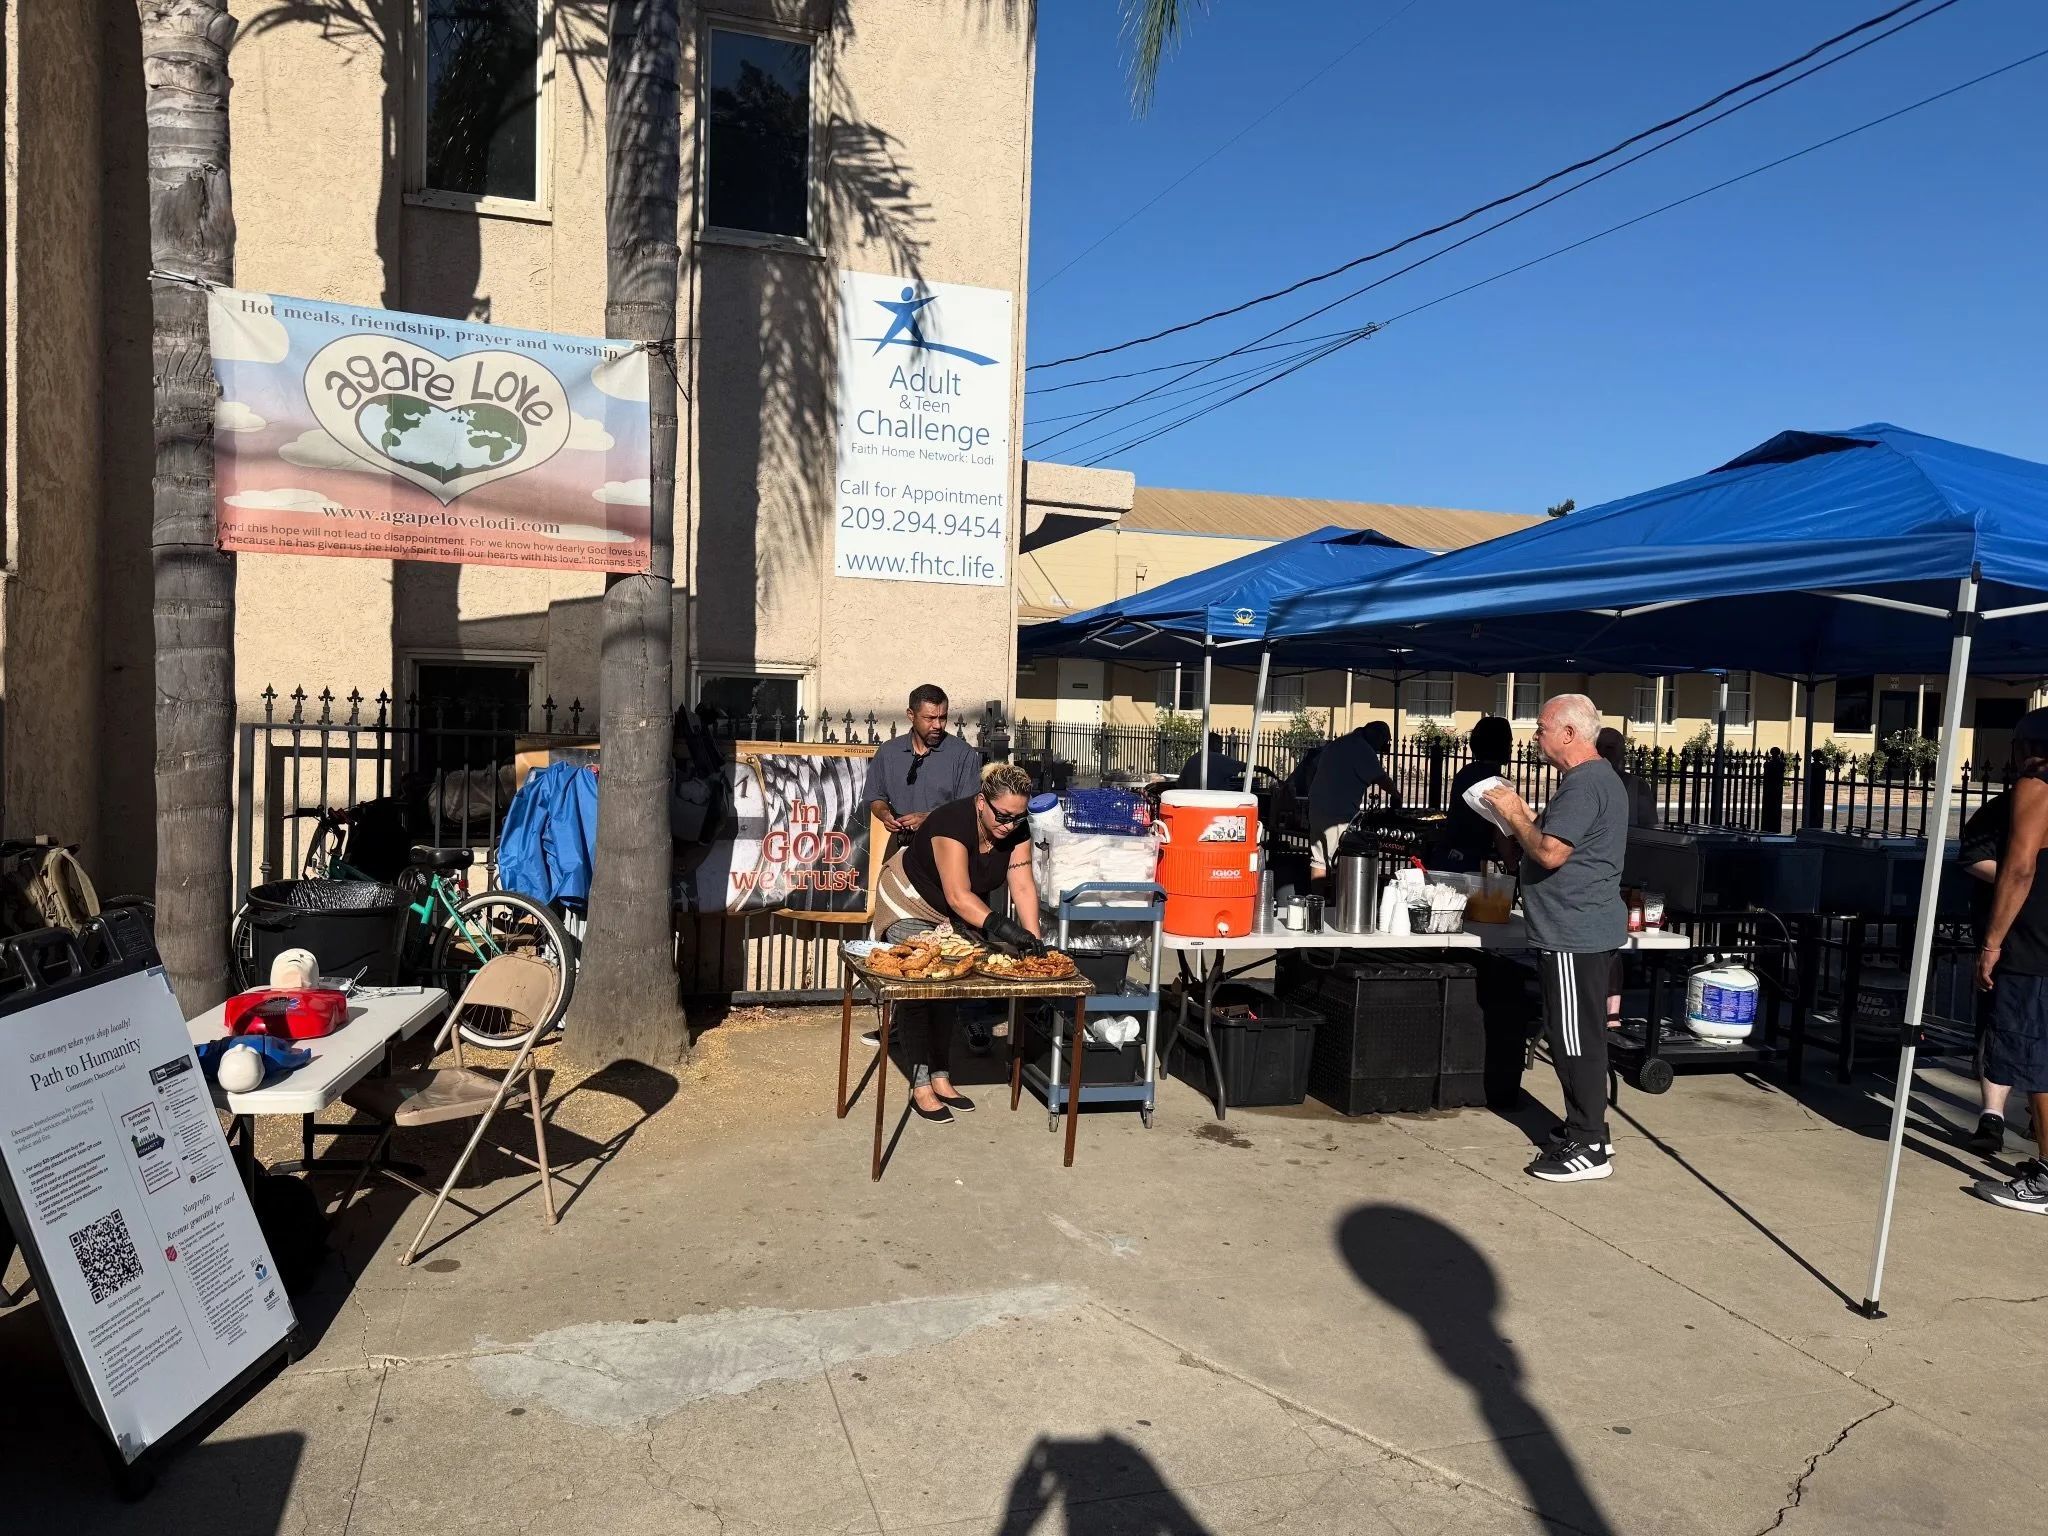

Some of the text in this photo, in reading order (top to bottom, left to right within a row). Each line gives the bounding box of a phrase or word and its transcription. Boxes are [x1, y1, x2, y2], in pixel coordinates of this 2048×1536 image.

[242, 300, 621, 361] Hot meals, friendship, prayer and worship.
[471, 361, 553, 426] Love
[889, 365, 962, 396] Adult
[899, 395, 950, 413] & Teen
[856, 409, 990, 451] Challenge
[851, 442, 994, 465] Faith Home Network: Lodi
[840, 479, 1004, 507] Call for Appointment
[322, 507, 560, 534] www.agapelovelodi.com
[840, 505, 1001, 539] 209.294.9454
[228, 534, 276, 546] because
[279, 538, 293, 547] he
[295, 538, 315, 548] has
[317, 540, 347, 550] given
[348, 542, 362, 551] us
[364, 543, 382, 552] the
[385, 544, 408, 554] Holy
[410, 545, 437, 555] Spirit
[440, 547, 450, 556] to
[453, 548, 465, 557] fill
[467, 550, 484, 558] our
[487, 550, 518, 560] hearts
[520, 552, 540, 561] with
[543, 554, 557, 563] his
[588, 557, 625, 567] Romans
[627, 559, 642, 568] 5:5
[247, 523, 268, 533] this
[271, 524, 300, 536] hope
[302, 527, 321, 537] will
[323, 528, 341, 538] not
[344, 529, 367, 539] lead
[370, 531, 380, 540] to
[384, 532, 466, 546] disappointment.
[470, 538, 486, 547] For
[488, 540, 502, 548] we
[505, 540, 531, 550] know
[533, 542, 554, 551] how
[556, 543, 585, 555] dearly
[587, 545, 606, 555] God
[609, 547, 632, 557] loves
[635, 548, 648, 558] us,
[846, 551, 995, 579] www.fhtc.life
[790, 799, 821, 824] In
[762, 831, 851, 864] GOD
[730, 867, 860, 891] we trust
[1857, 992, 1883, 1006] lue
[29, 1066, 64, 1091] Path
[64, 1064, 79, 1077] to
[78, 1037, 140, 1071] Humanity
